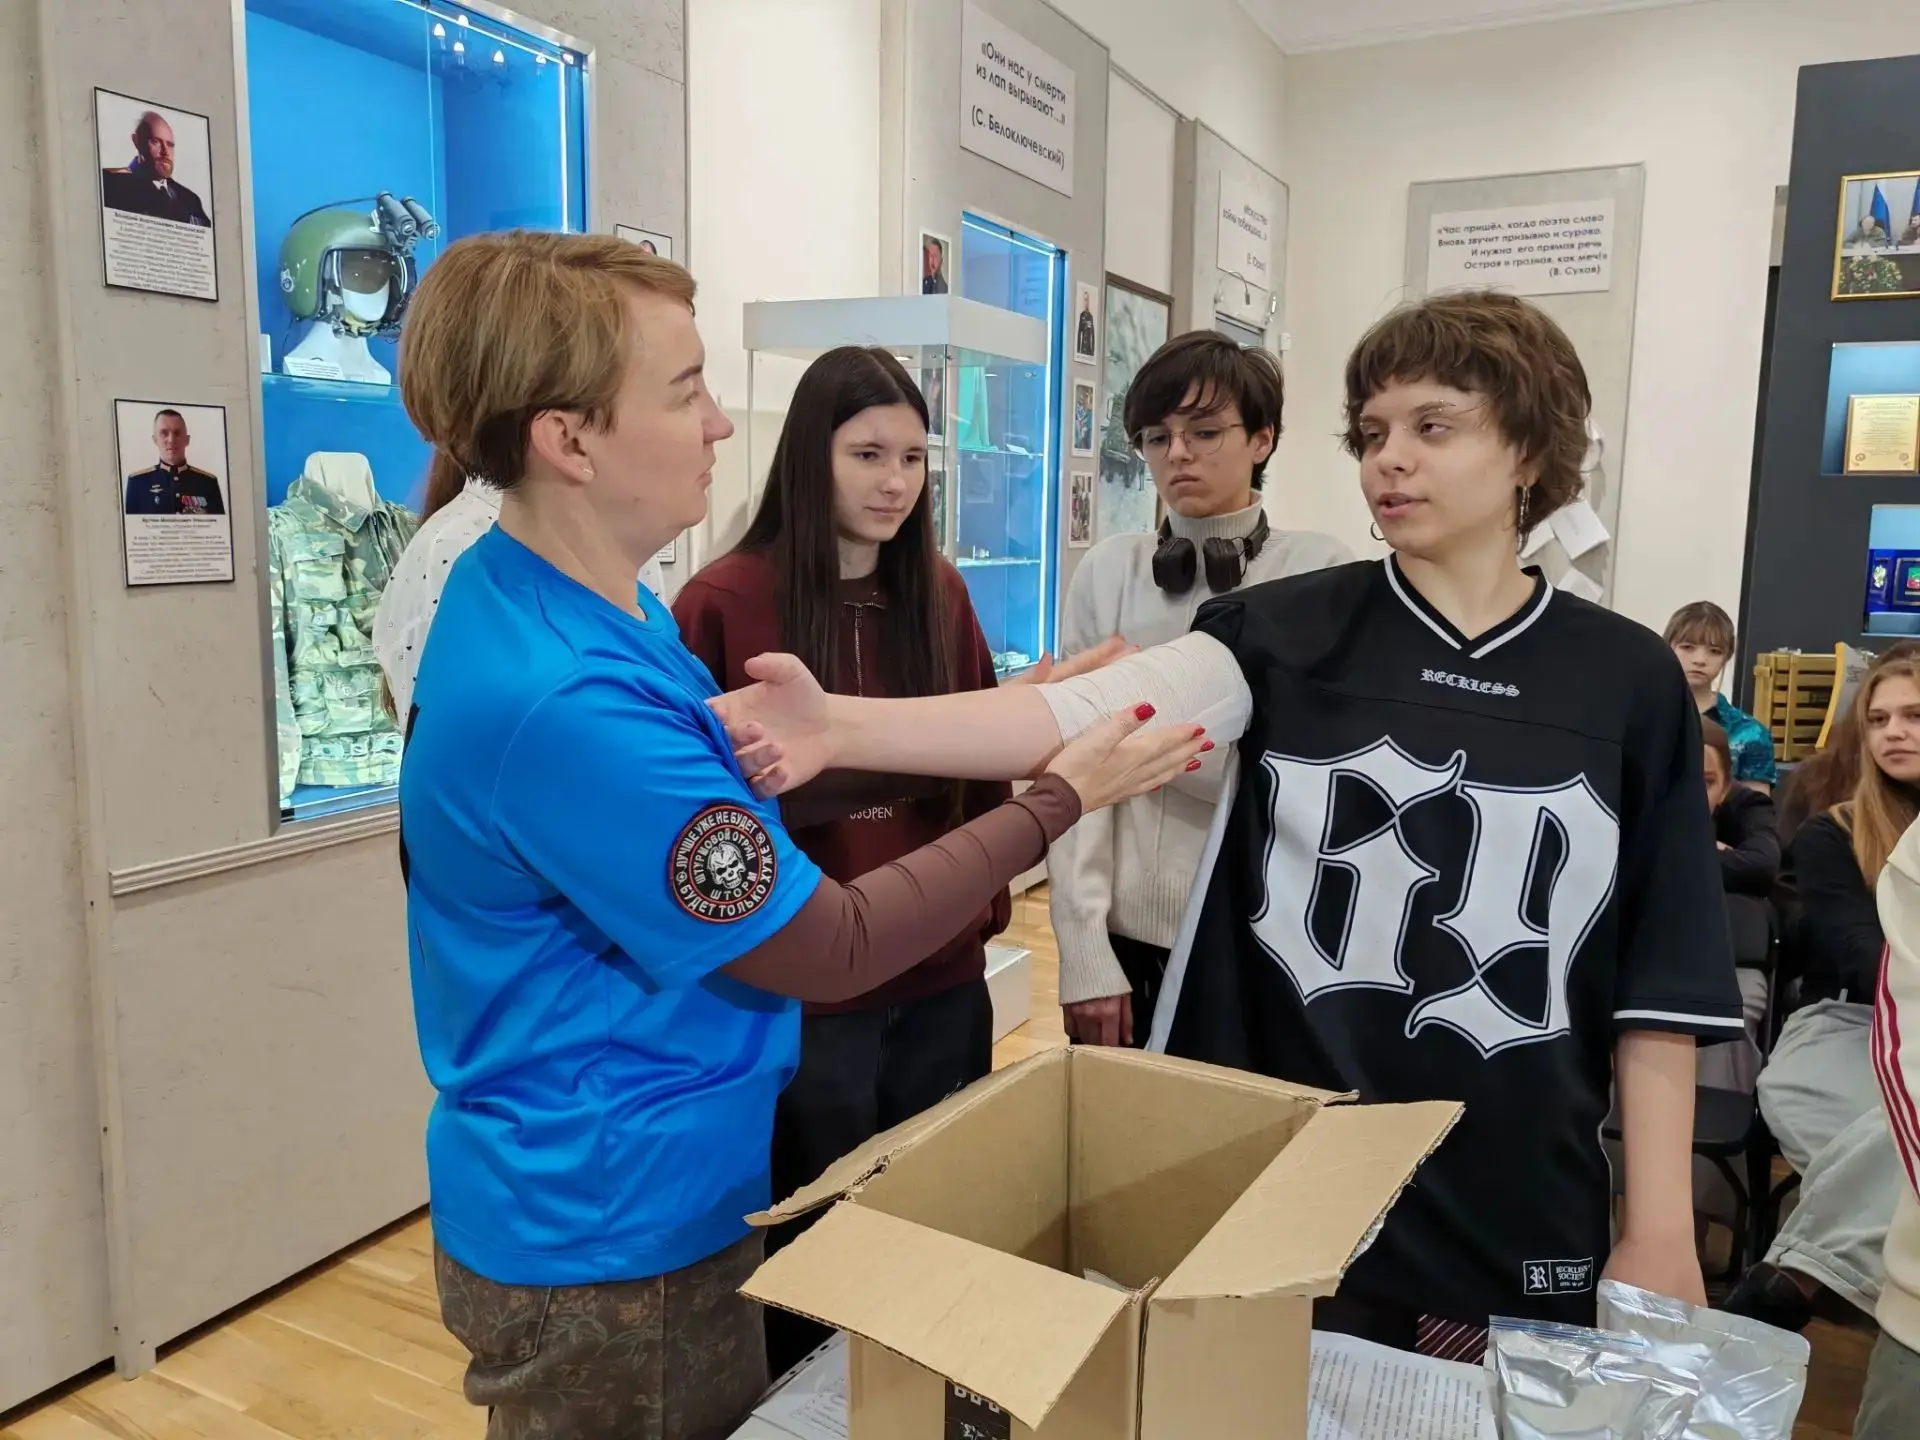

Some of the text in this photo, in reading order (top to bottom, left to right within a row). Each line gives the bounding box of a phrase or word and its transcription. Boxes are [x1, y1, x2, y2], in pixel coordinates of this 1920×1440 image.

[976, 63, 987, 80] из
[989, 71, 1006, 92] лап
[1008, 60, 1025, 79] нас
[1027, 70, 1033, 87] у
[1034, 76, 1066, 104] смерти
[989, 115, 1065, 171] Белоключевский)
[1468, 236, 1500, 246] звучит
[1503, 232, 1551, 242] призывно
[1508, 220, 1536, 229] когда
[1573, 214, 1604, 224] слово
[1480, 247, 1512, 257] нужна
[1420, 668, 1520, 697] RECKLESS
[676, 811, 758, 868] ЛУЧШЕ УЖЕ НЕ БУДЕТ
[694, 827, 757, 885] ШТУРМОВОЙ ОТРЯД
[680, 845, 773, 917] БУДЕТ ТОЛЬКО ХУЖЕ
